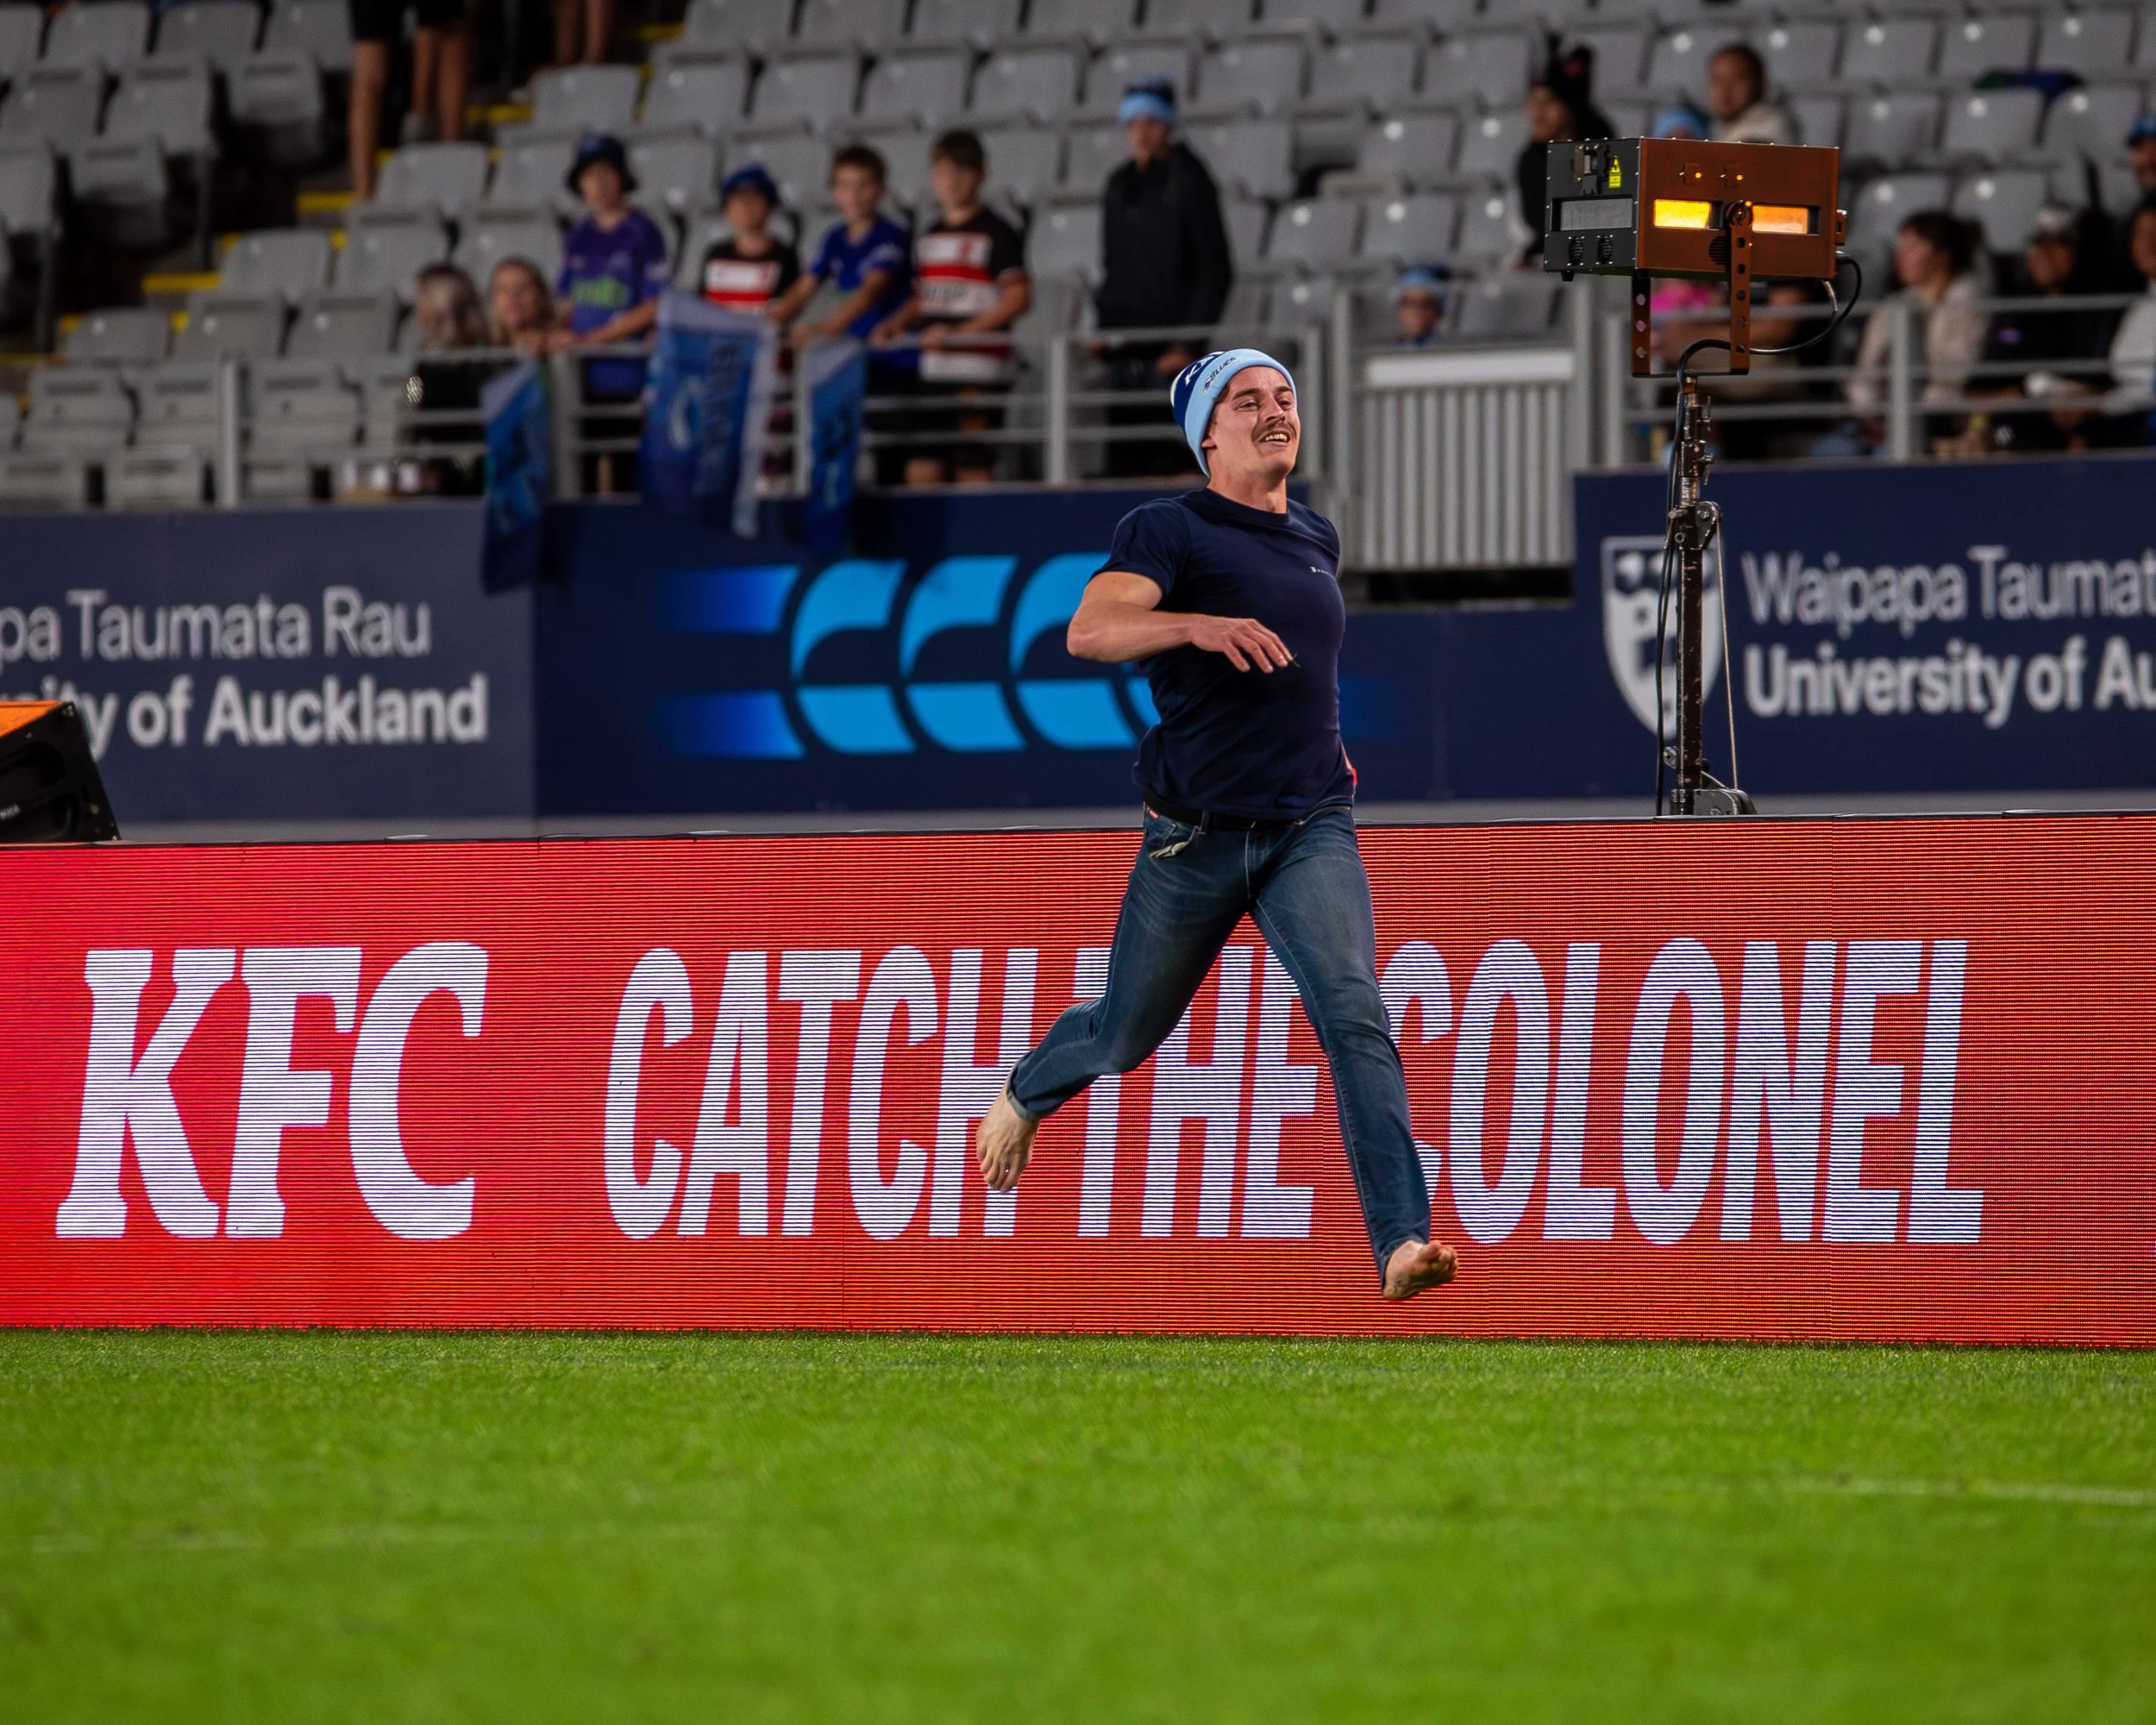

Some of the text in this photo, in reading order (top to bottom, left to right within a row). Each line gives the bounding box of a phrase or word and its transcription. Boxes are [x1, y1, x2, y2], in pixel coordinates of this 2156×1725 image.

[66, 588, 311, 661] Taumata
[322, 585, 432, 658] Rau
[1741, 552, 1968, 638] Waipapa
[126, 674, 193, 748] of
[203, 671, 489, 748] Auckland
[1744, 639, 2021, 729] University
[2025, 634, 2086, 712] of
[56, 941, 488, 1239] KFC
[604, 945, 1038, 1240] CATCH
[1072, 945, 1319, 1239] THE
